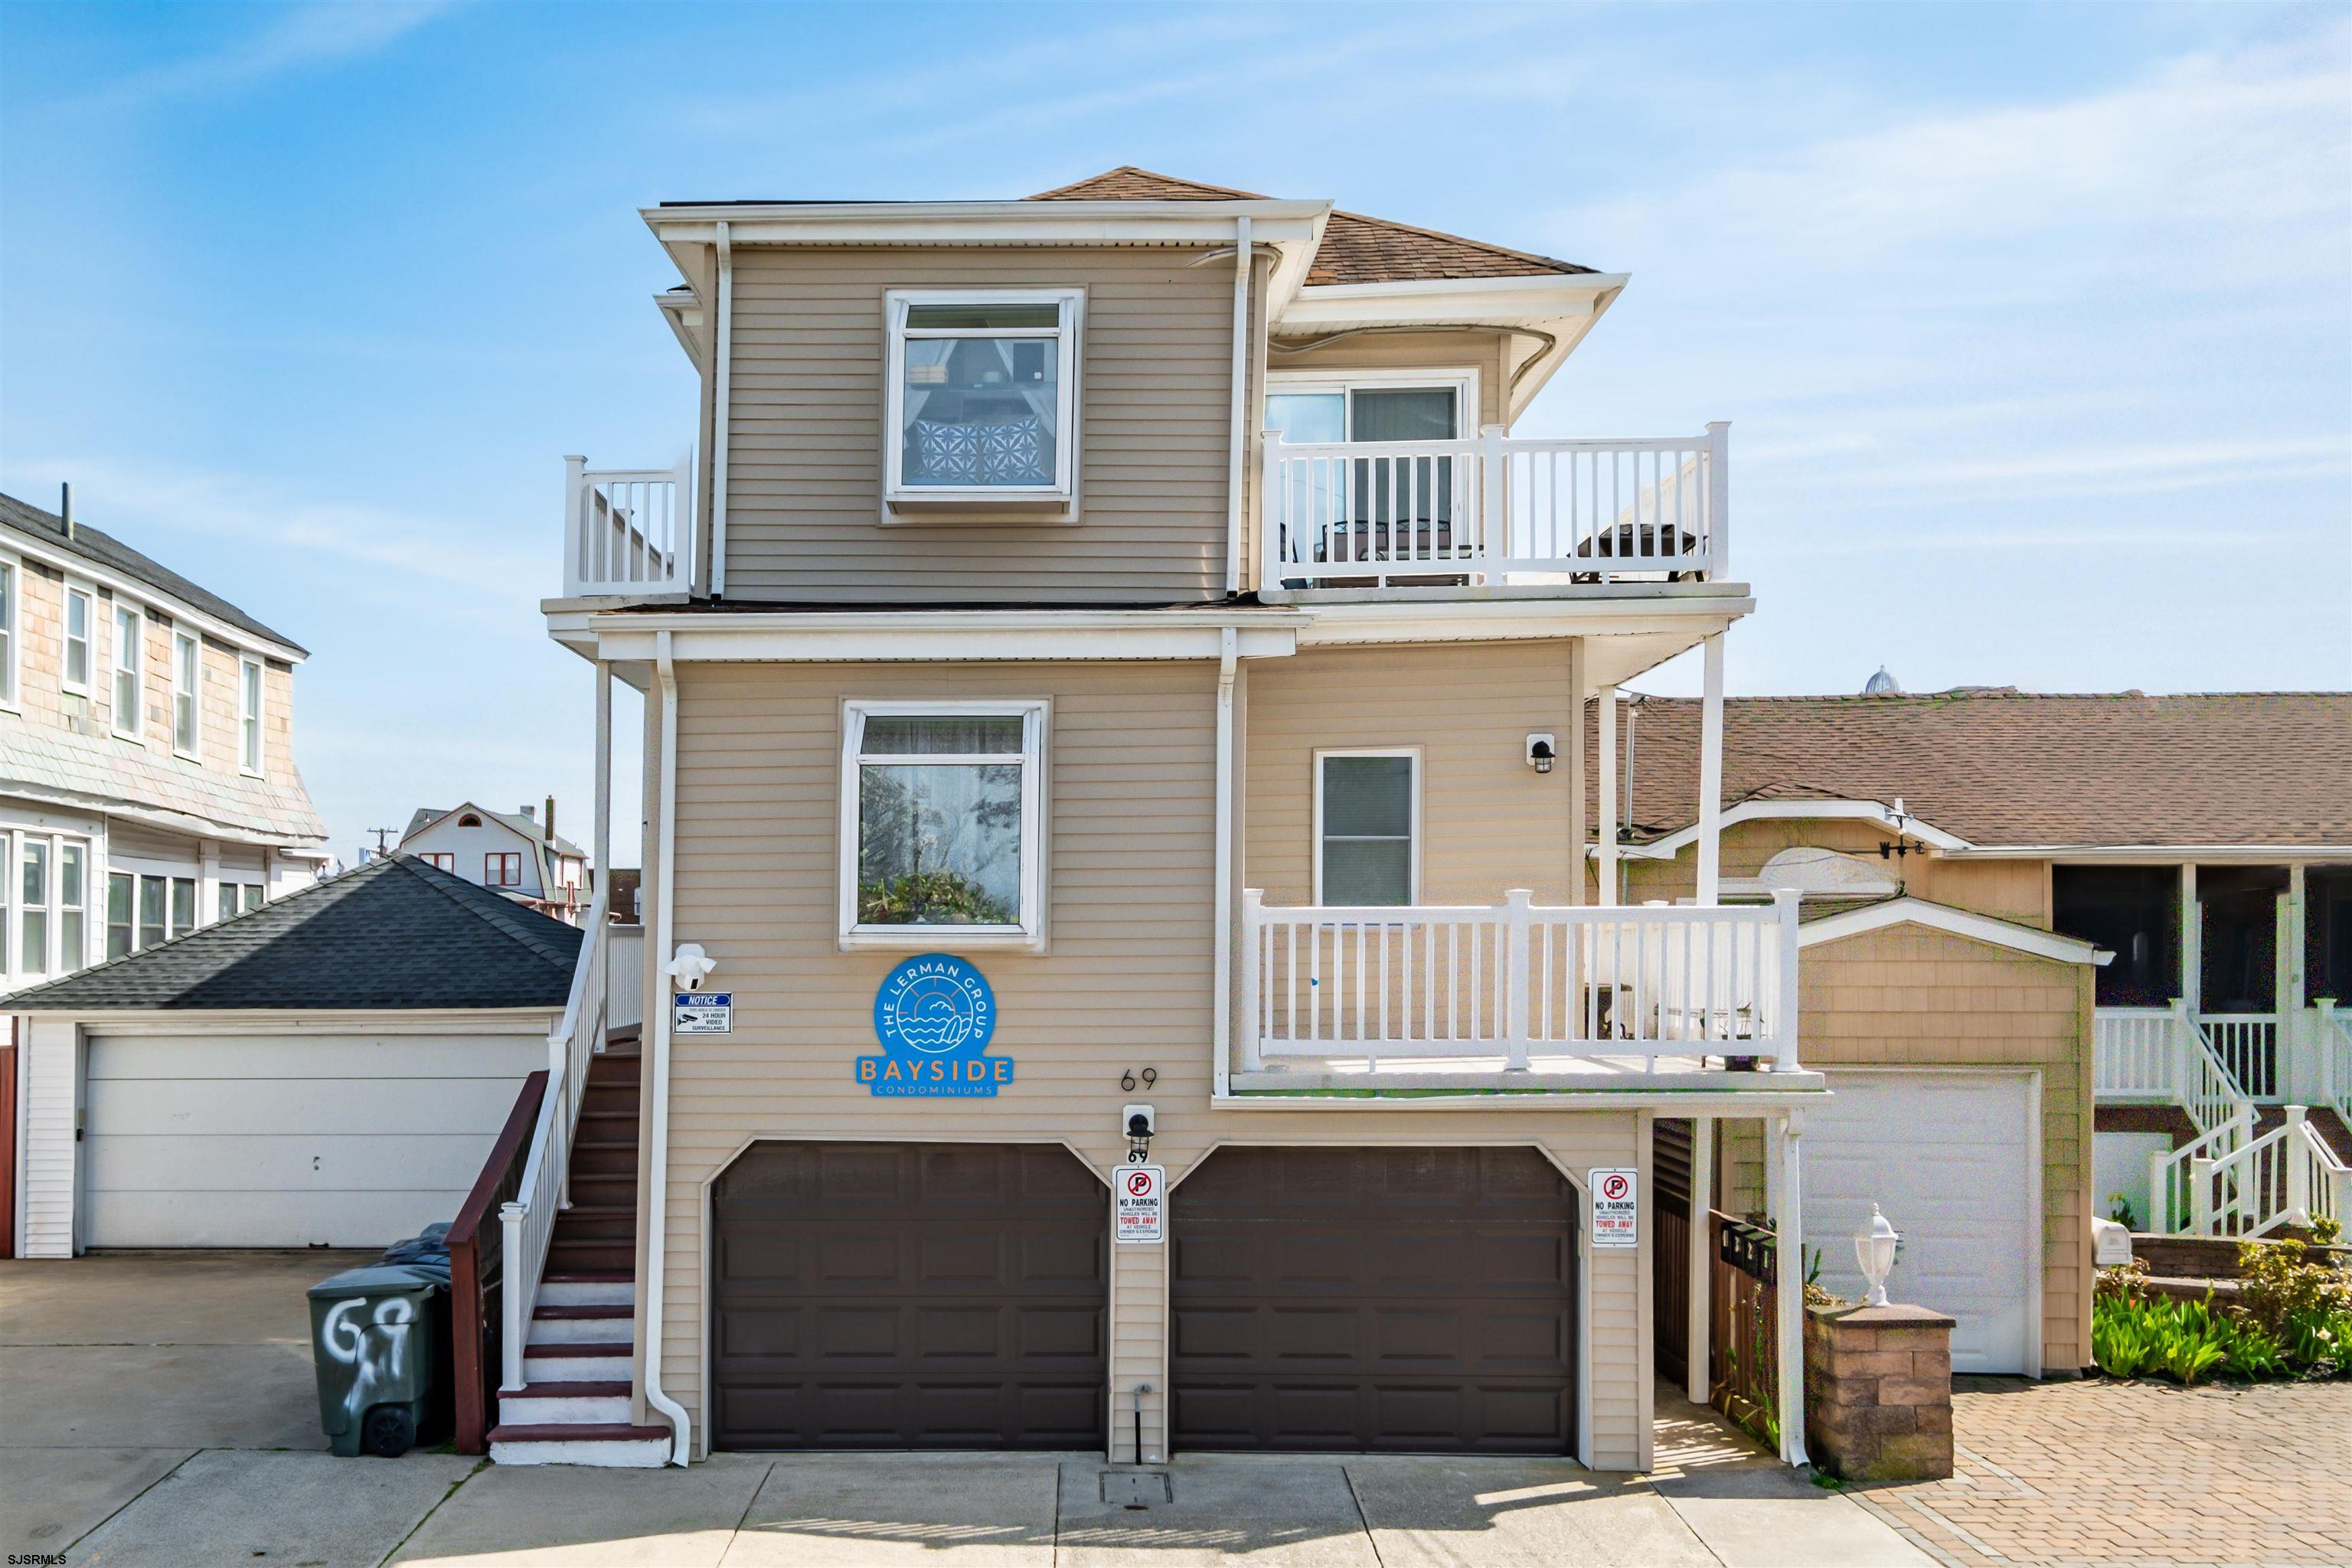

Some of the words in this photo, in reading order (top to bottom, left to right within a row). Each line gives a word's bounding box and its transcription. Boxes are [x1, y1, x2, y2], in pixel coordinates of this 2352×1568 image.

[890, 962, 959, 995] LERMAN
[688, 996, 718, 1004] NOTICE
[964, 978, 987, 1039] GROUP
[884, 1002, 897, 1037] THE
[861, 1060, 1008, 1081] BAYSIDE
[1121, 1067, 1157, 1091] 69
[877, 1086, 992, 1095] CONDOMINIUMS
[1129, 1150, 1148, 1163] 69
[322, 1297, 413, 1378] 69
